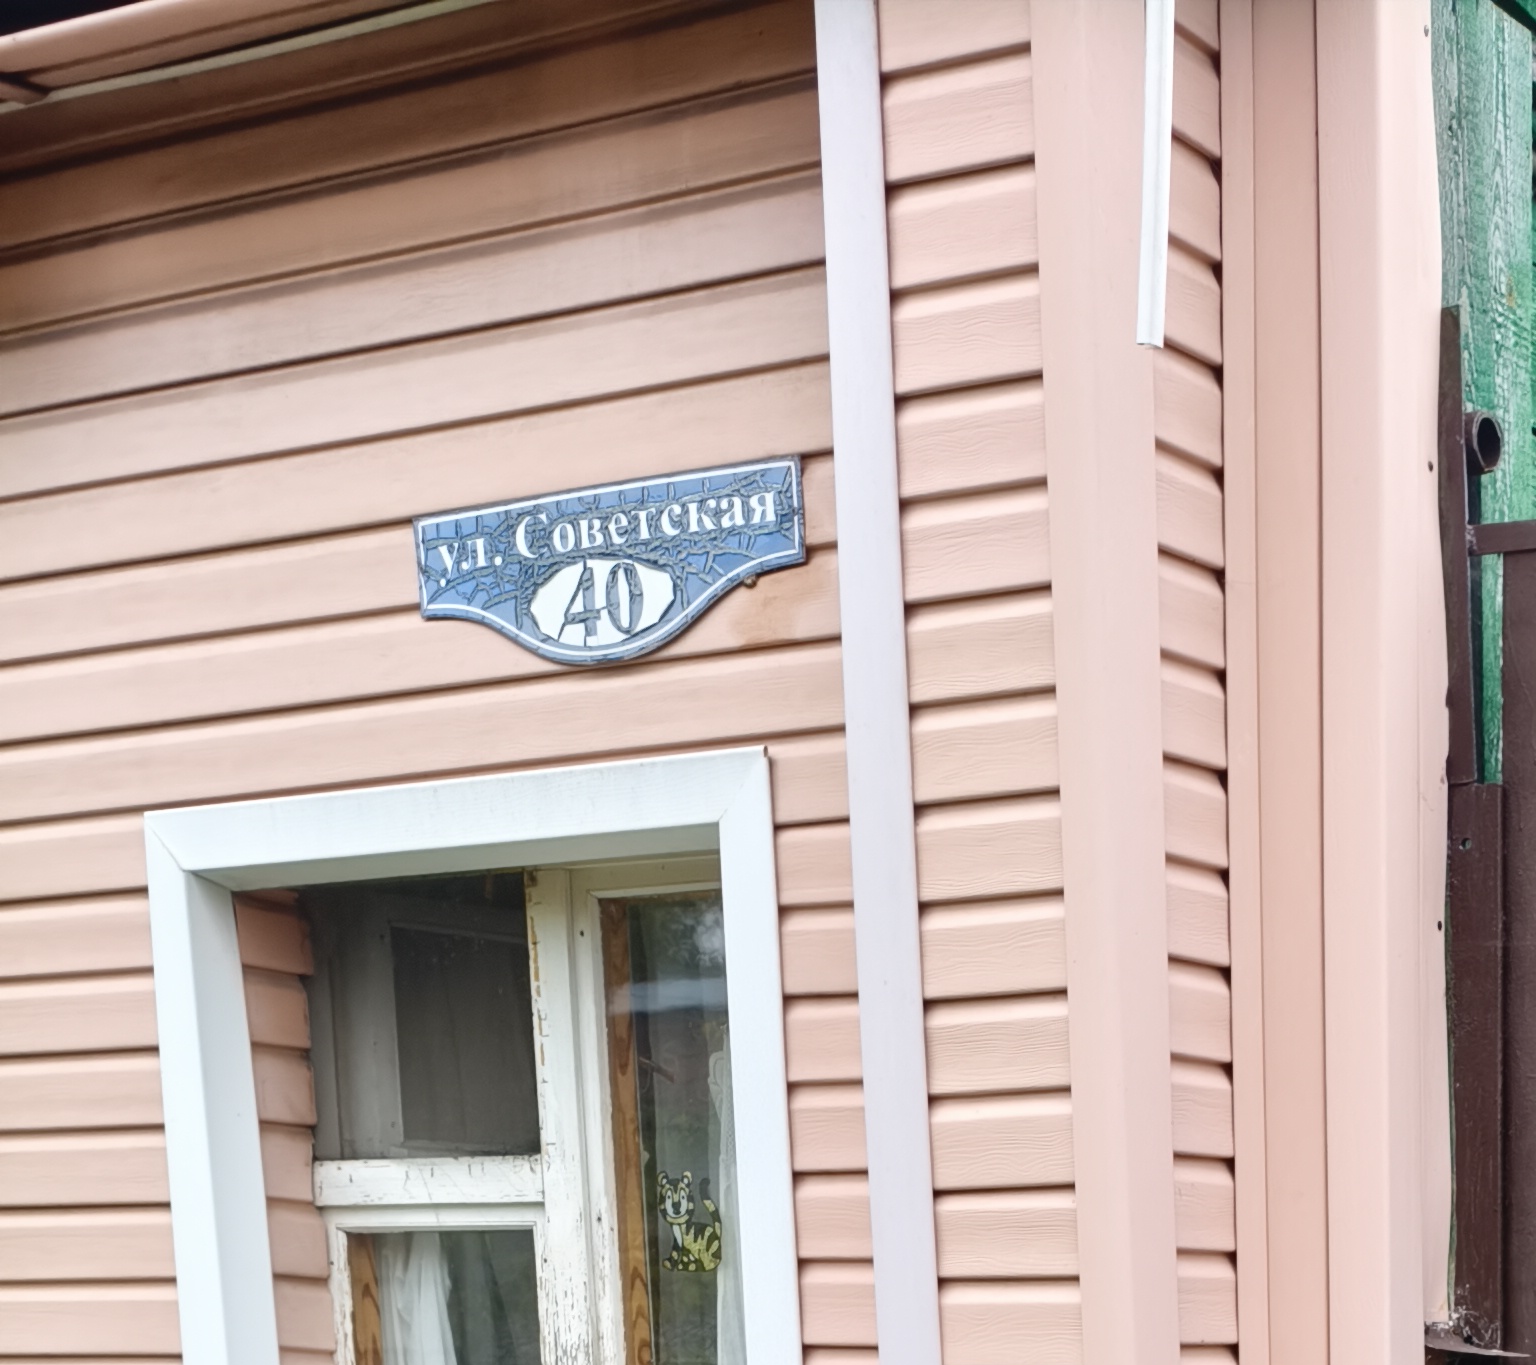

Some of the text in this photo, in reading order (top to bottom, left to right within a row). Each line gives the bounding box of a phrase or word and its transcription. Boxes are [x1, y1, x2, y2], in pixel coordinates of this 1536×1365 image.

[437, 491, 778, 588] ул. Советская
[557, 561, 645, 643] 40
